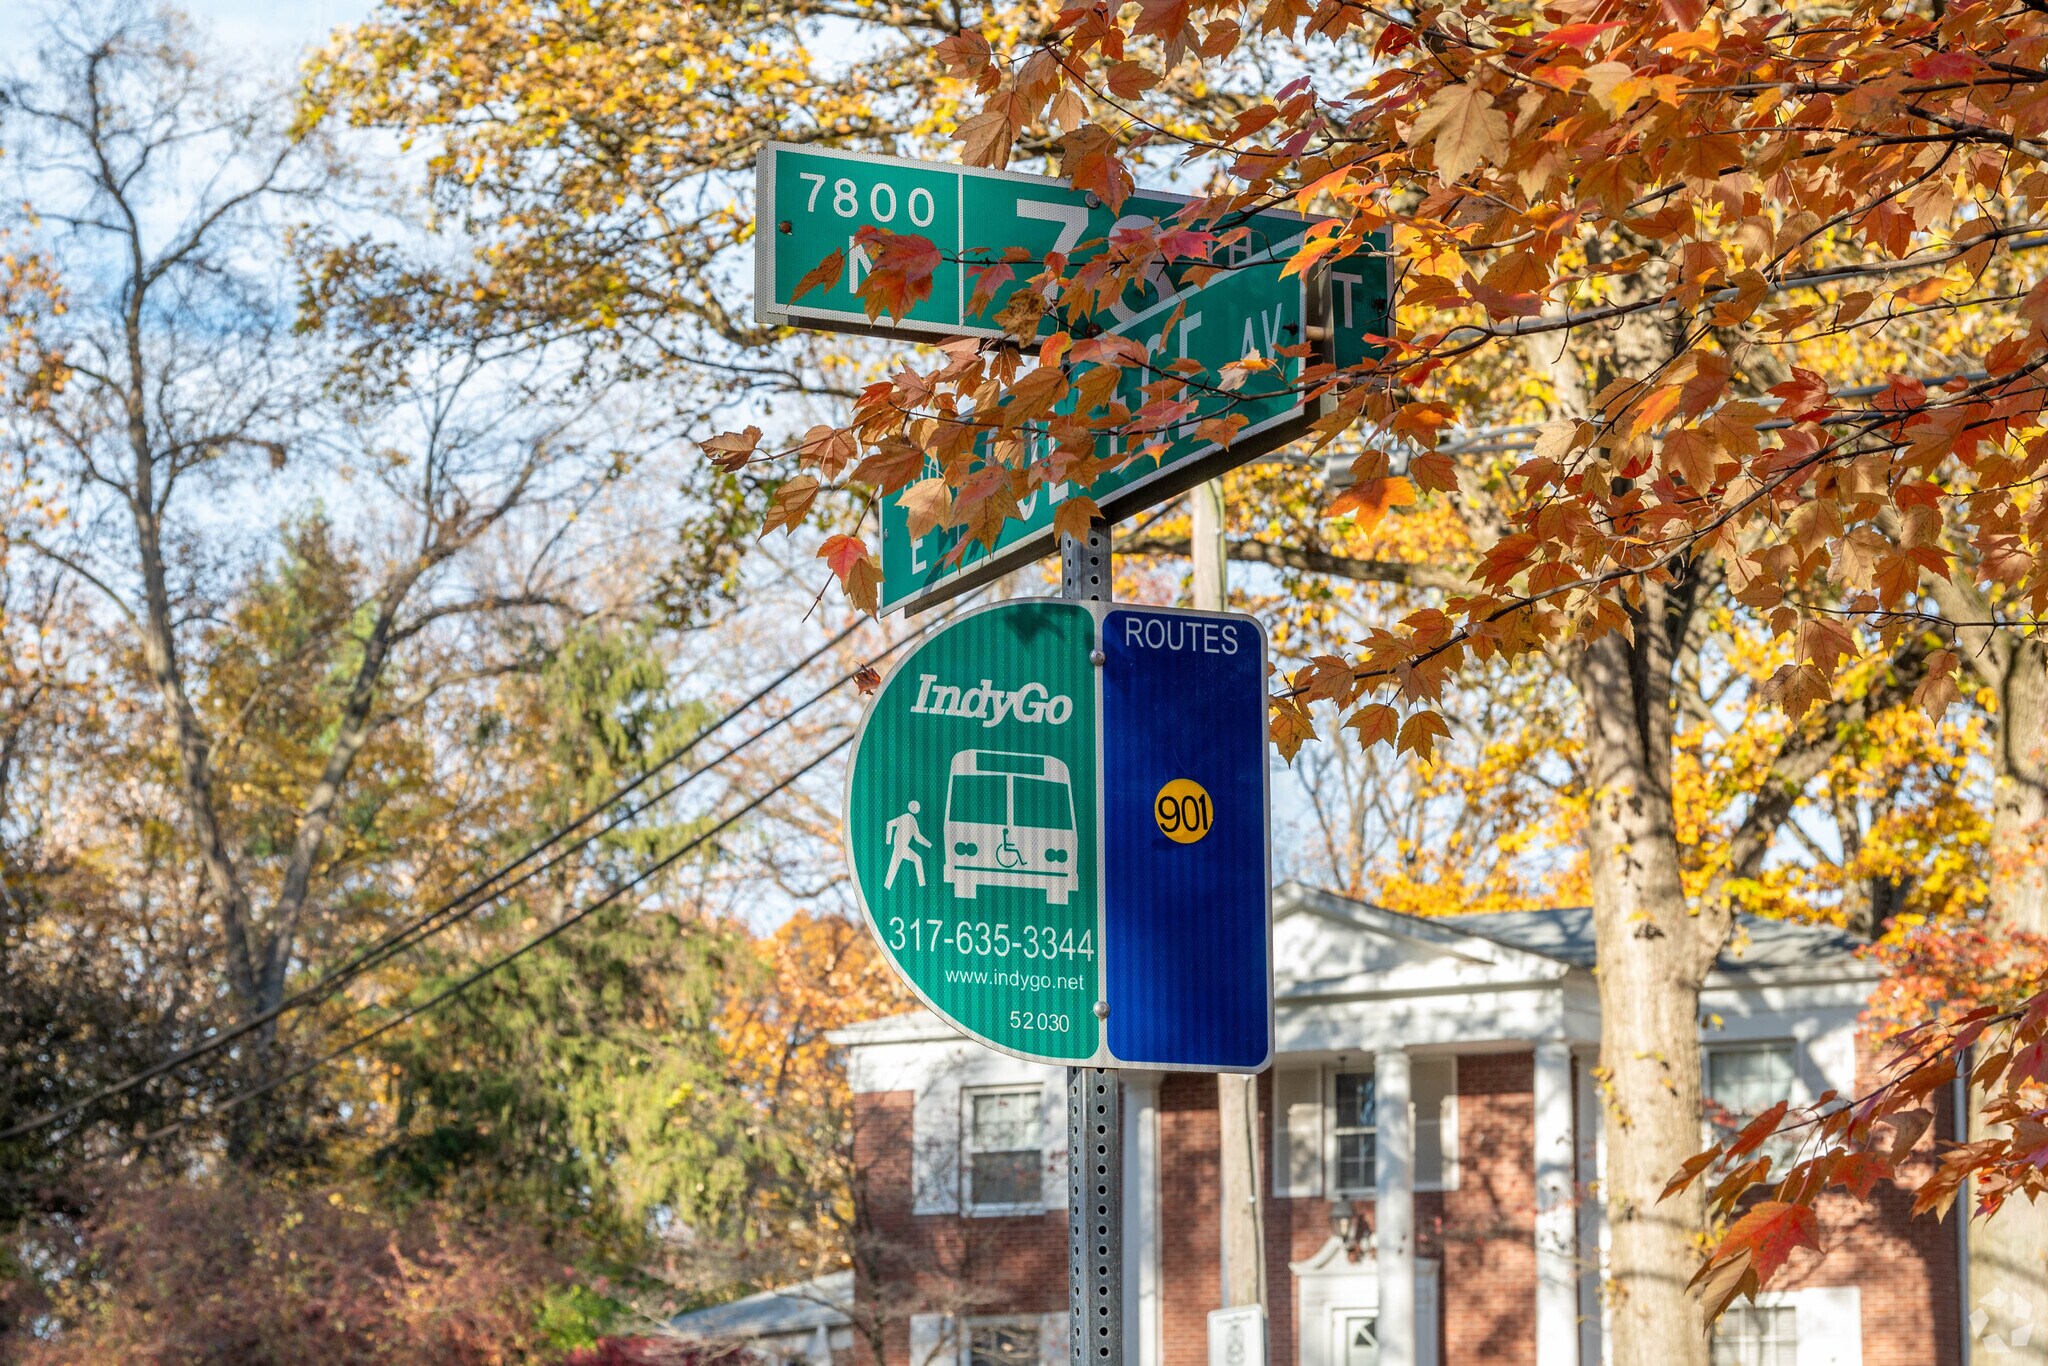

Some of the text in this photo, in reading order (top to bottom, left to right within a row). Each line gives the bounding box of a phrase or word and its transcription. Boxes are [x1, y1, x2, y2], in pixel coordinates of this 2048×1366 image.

[800, 172, 935, 228] 7800
[1125, 617, 1239, 656] ROUTES
[910, 674, 1073, 728] IndyGo
[1158, 793, 1210, 834] 901
[889, 916, 1095, 962] 317-635-3344
[945, 968, 1085, 992] www.indygo.net
[1009, 1010, 1070, 1033] 52030
